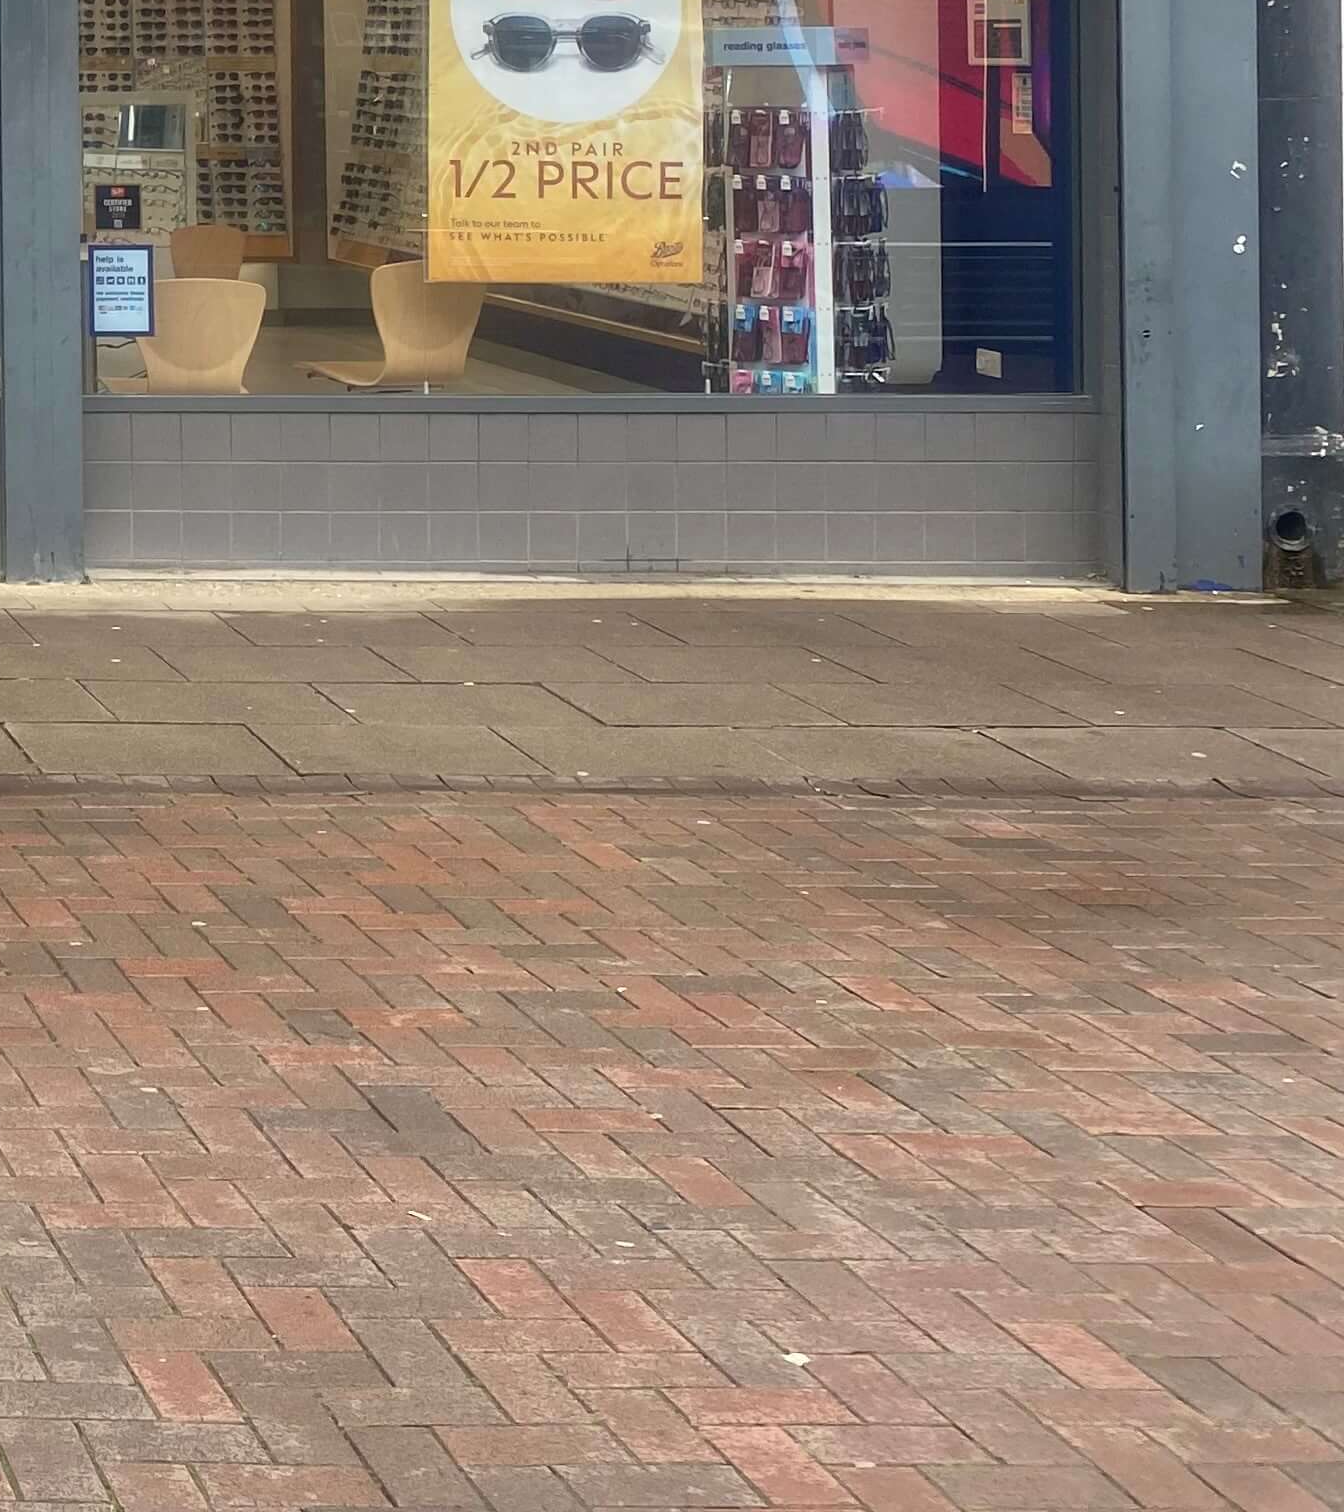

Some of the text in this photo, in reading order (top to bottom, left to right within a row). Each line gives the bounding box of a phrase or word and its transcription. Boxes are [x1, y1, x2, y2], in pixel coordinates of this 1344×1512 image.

[723, 41, 763, 52] reading
[511, 141, 624, 156] 2ND PAIR
[448, 159, 684, 200] 1/2 PRICE
[450, 218, 542, 229] Talk to our team to
[448, 232, 606, 242] SEE WHAT'S POSSIBLE
[95, 255, 113, 264] help
[95, 264, 134, 274] available
